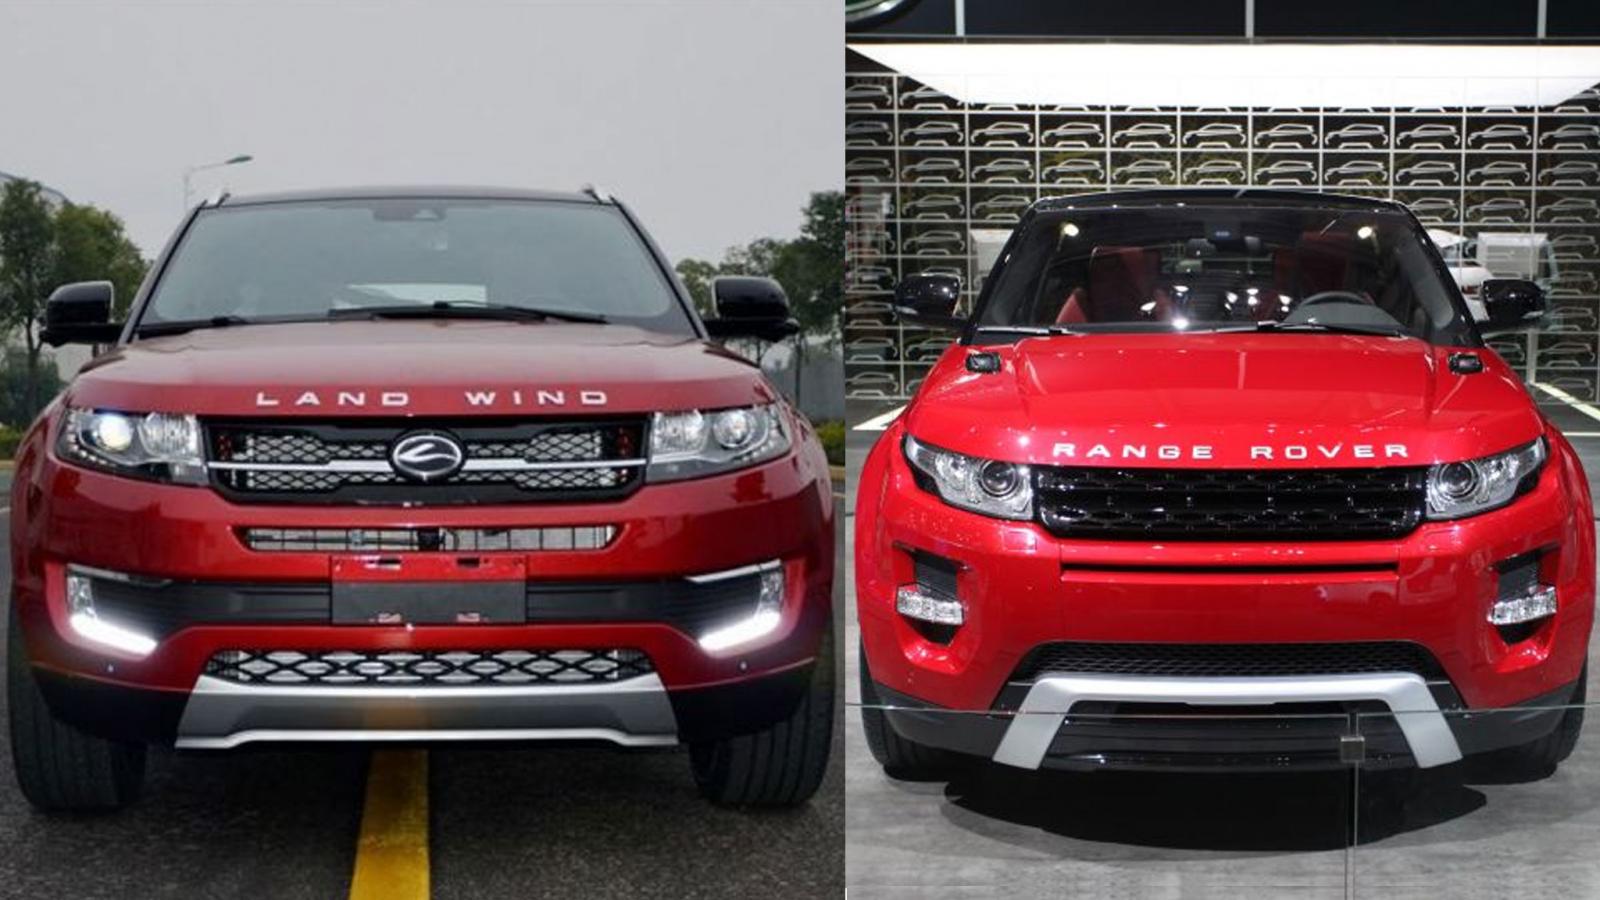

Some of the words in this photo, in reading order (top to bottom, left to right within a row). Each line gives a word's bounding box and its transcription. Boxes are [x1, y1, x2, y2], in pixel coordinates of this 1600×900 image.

[256, 391, 409, 407] LAND
[465, 390, 608, 406] WIND
[1052, 442, 1213, 459] RANGE
[1250, 444, 1409, 459] ROVER
